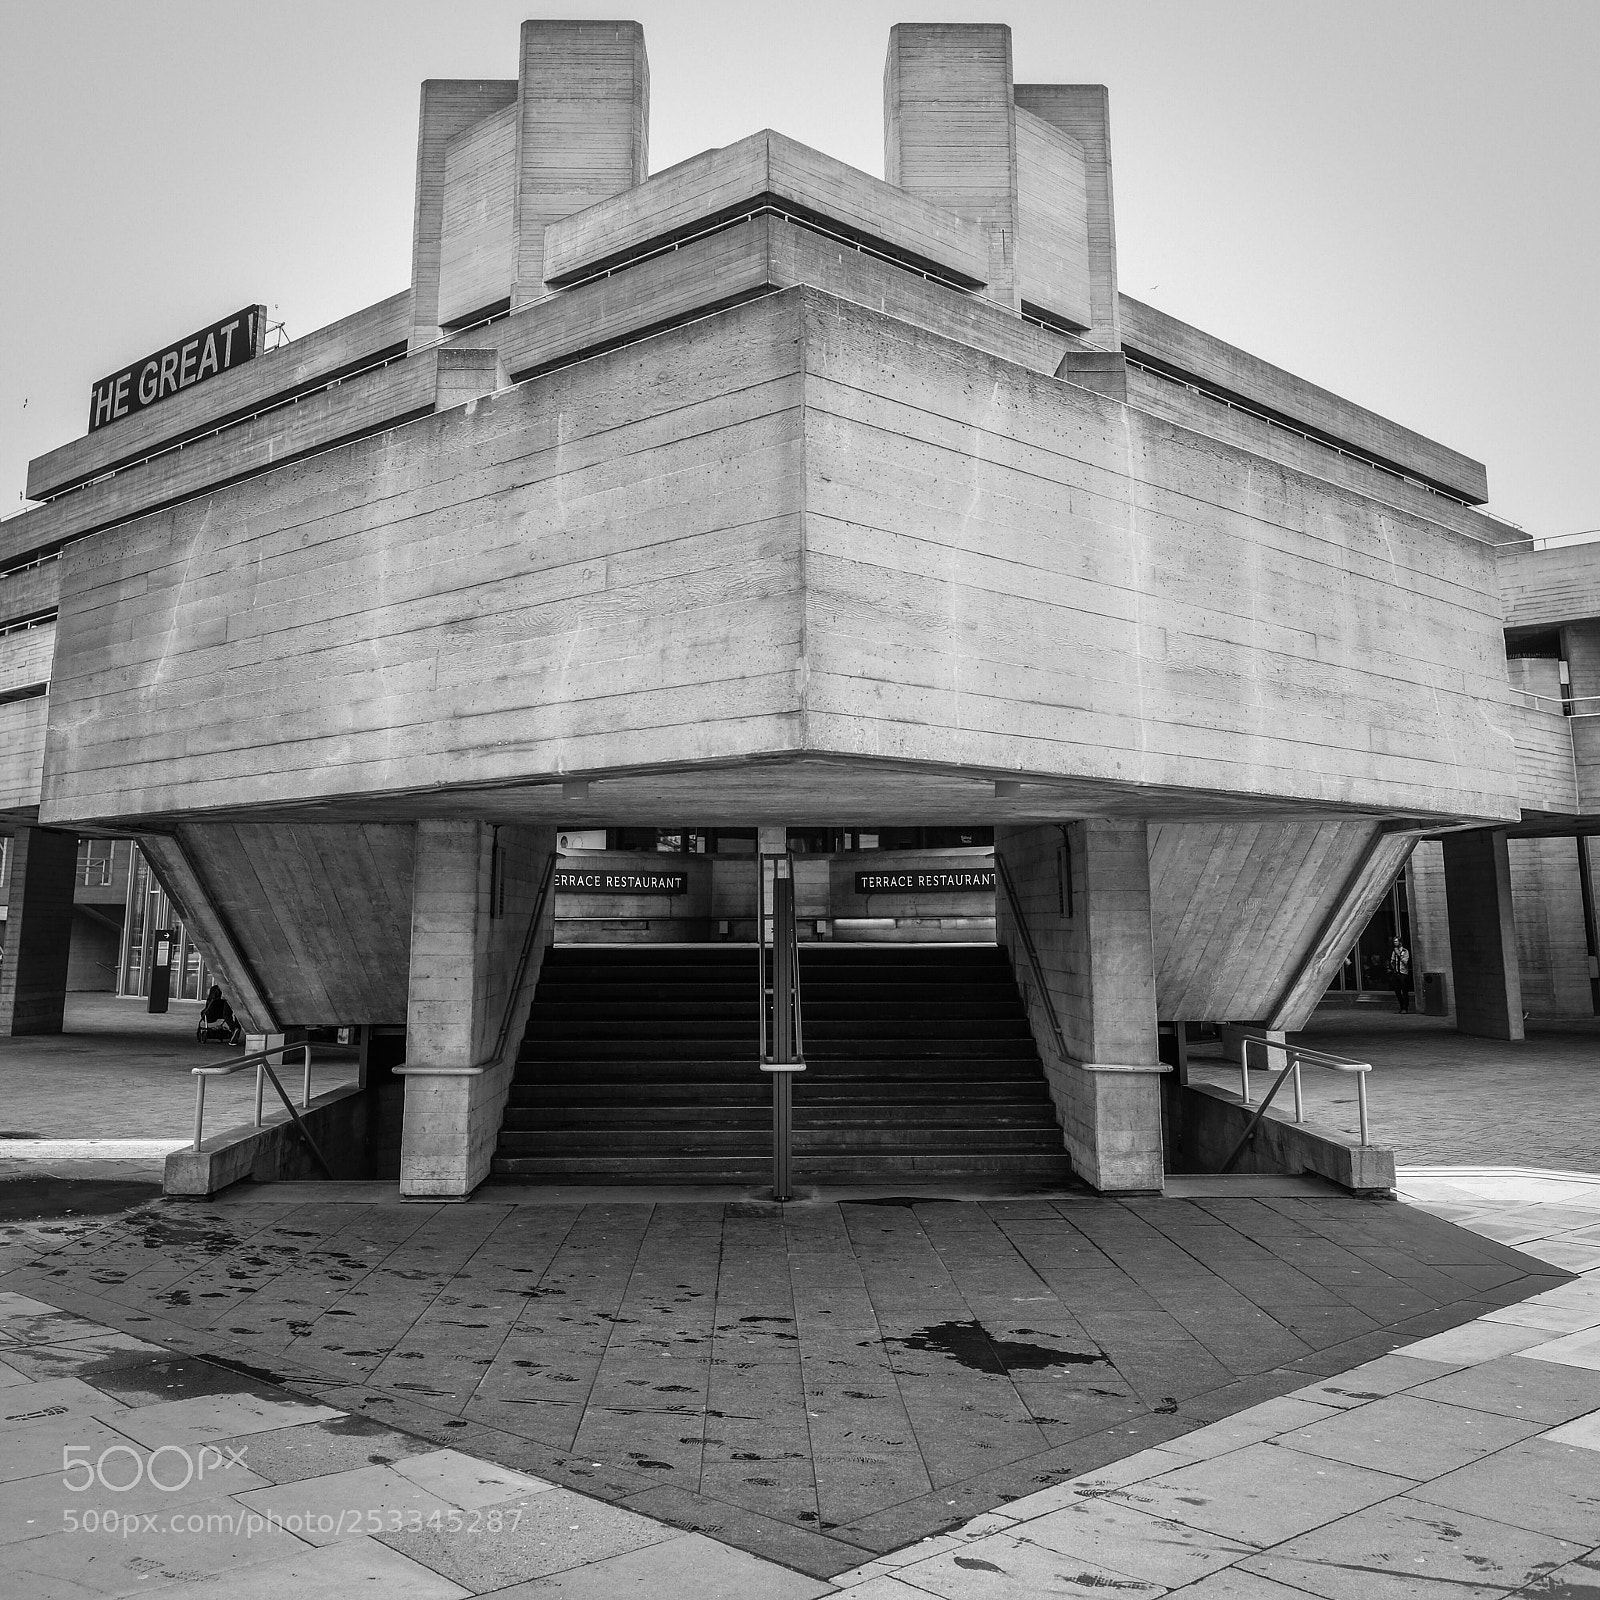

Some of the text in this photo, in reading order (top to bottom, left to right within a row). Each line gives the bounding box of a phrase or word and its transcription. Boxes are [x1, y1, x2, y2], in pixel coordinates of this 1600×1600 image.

[92, 372, 131, 427] HE
[138, 319, 240, 405] GREAT
[554, 874, 682, 889] ERRACE RESTAURANT
[861, 873, 996, 888] TERRACE RESTAURANT
